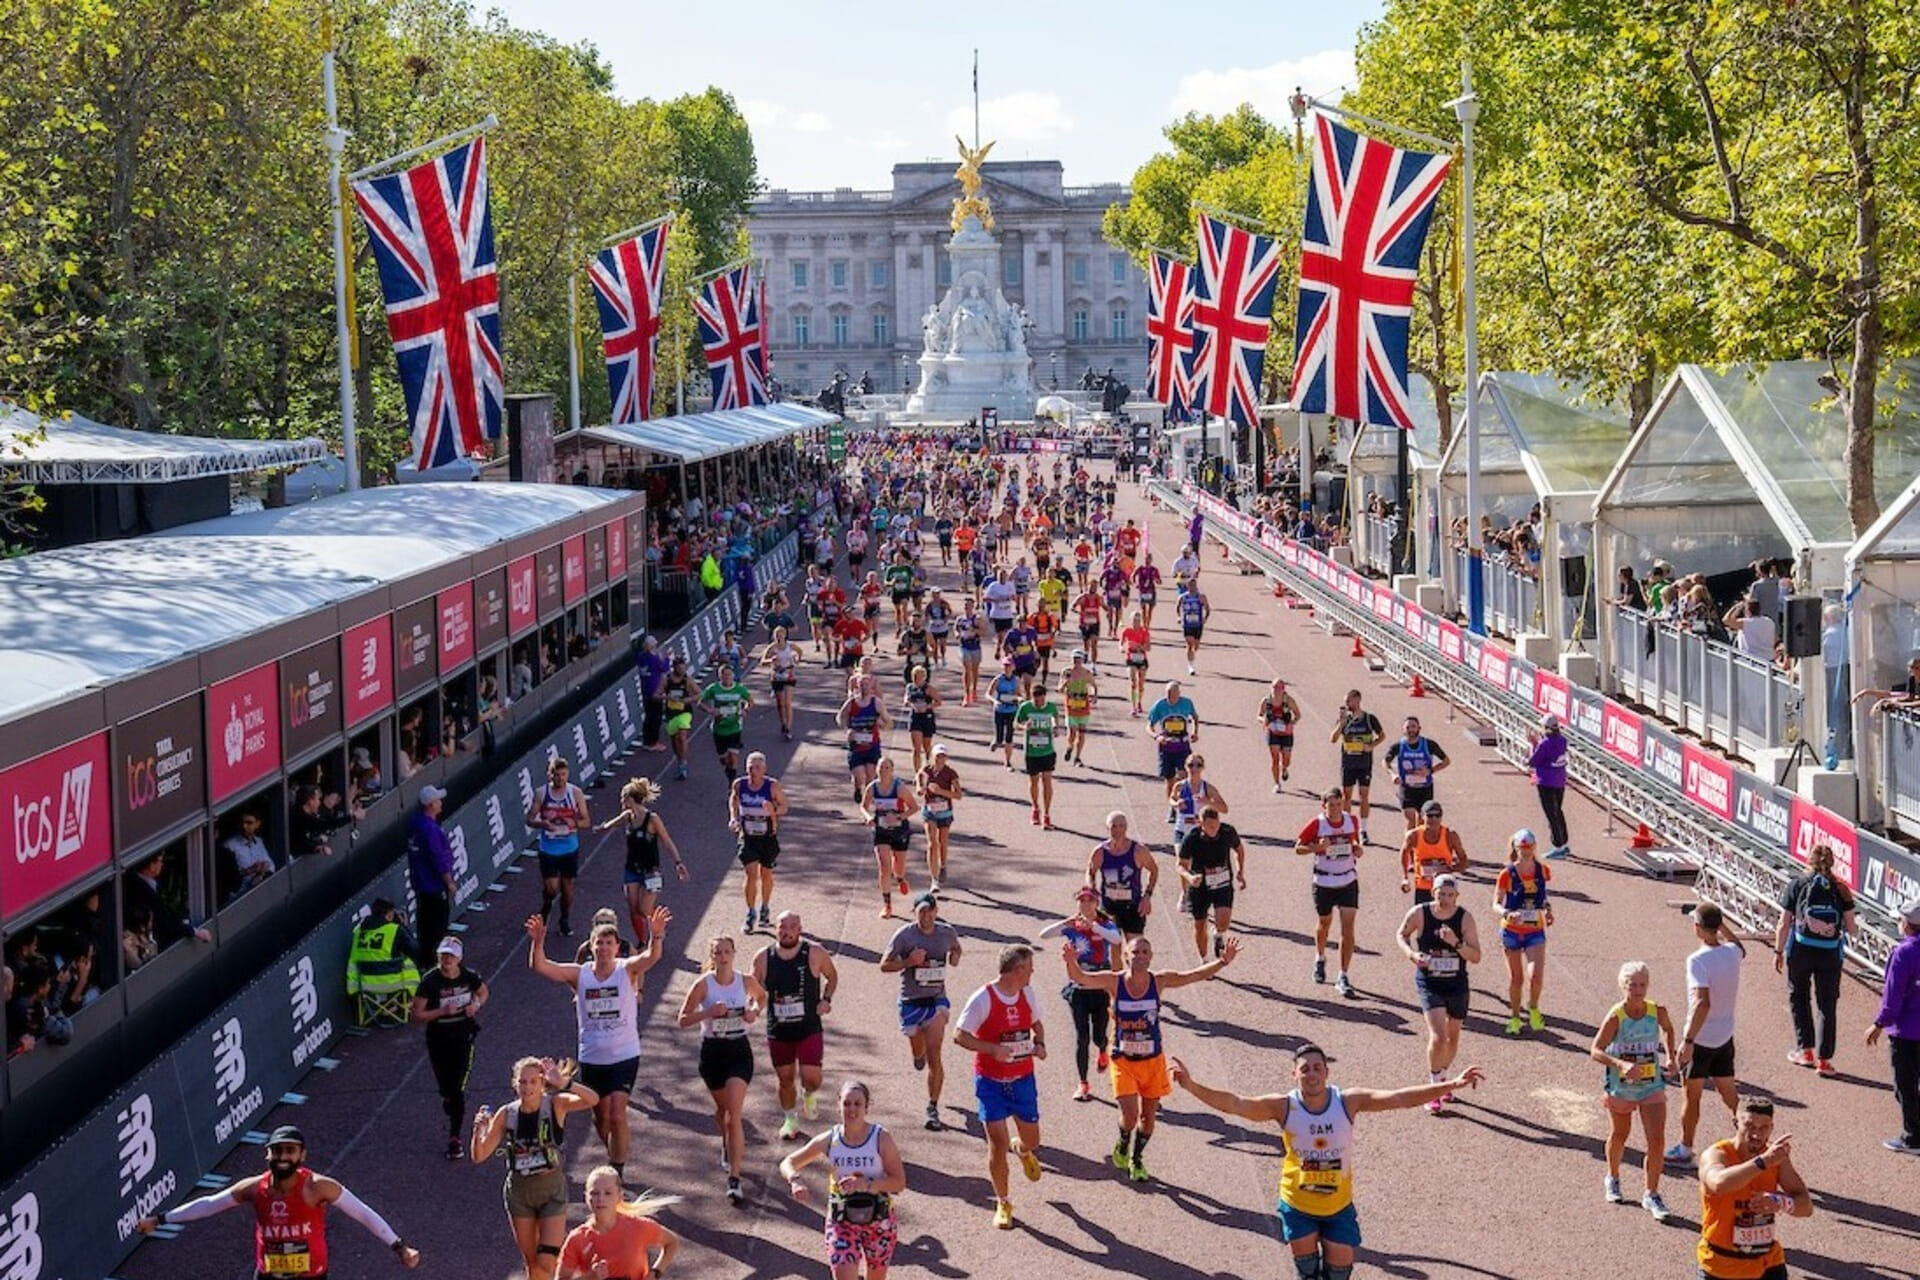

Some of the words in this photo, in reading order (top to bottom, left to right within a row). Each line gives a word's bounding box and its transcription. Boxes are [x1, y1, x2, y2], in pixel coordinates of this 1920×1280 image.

[156, 736, 173, 757] TATA
[244, 731, 266, 757] PARKS
[127, 755, 155, 811] tcs
[157, 772, 182, 798] SERVICES
[1763, 799, 1788, 828] LONDON
[13, 793, 52, 864] tcs
[1884, 860, 1901, 893] tcs
[303, 1018, 333, 1054] balance
[214, 1112, 233, 1145] new
[229, 1085, 264, 1129] balance
[1309, 1123, 1334, 1135] SAM
[833, 1156, 875, 1168] KIRSTY
[1293, 1147, 1341, 1161] ospice
[116, 1206, 139, 1242] new
[135, 1169, 177, 1219] balance
